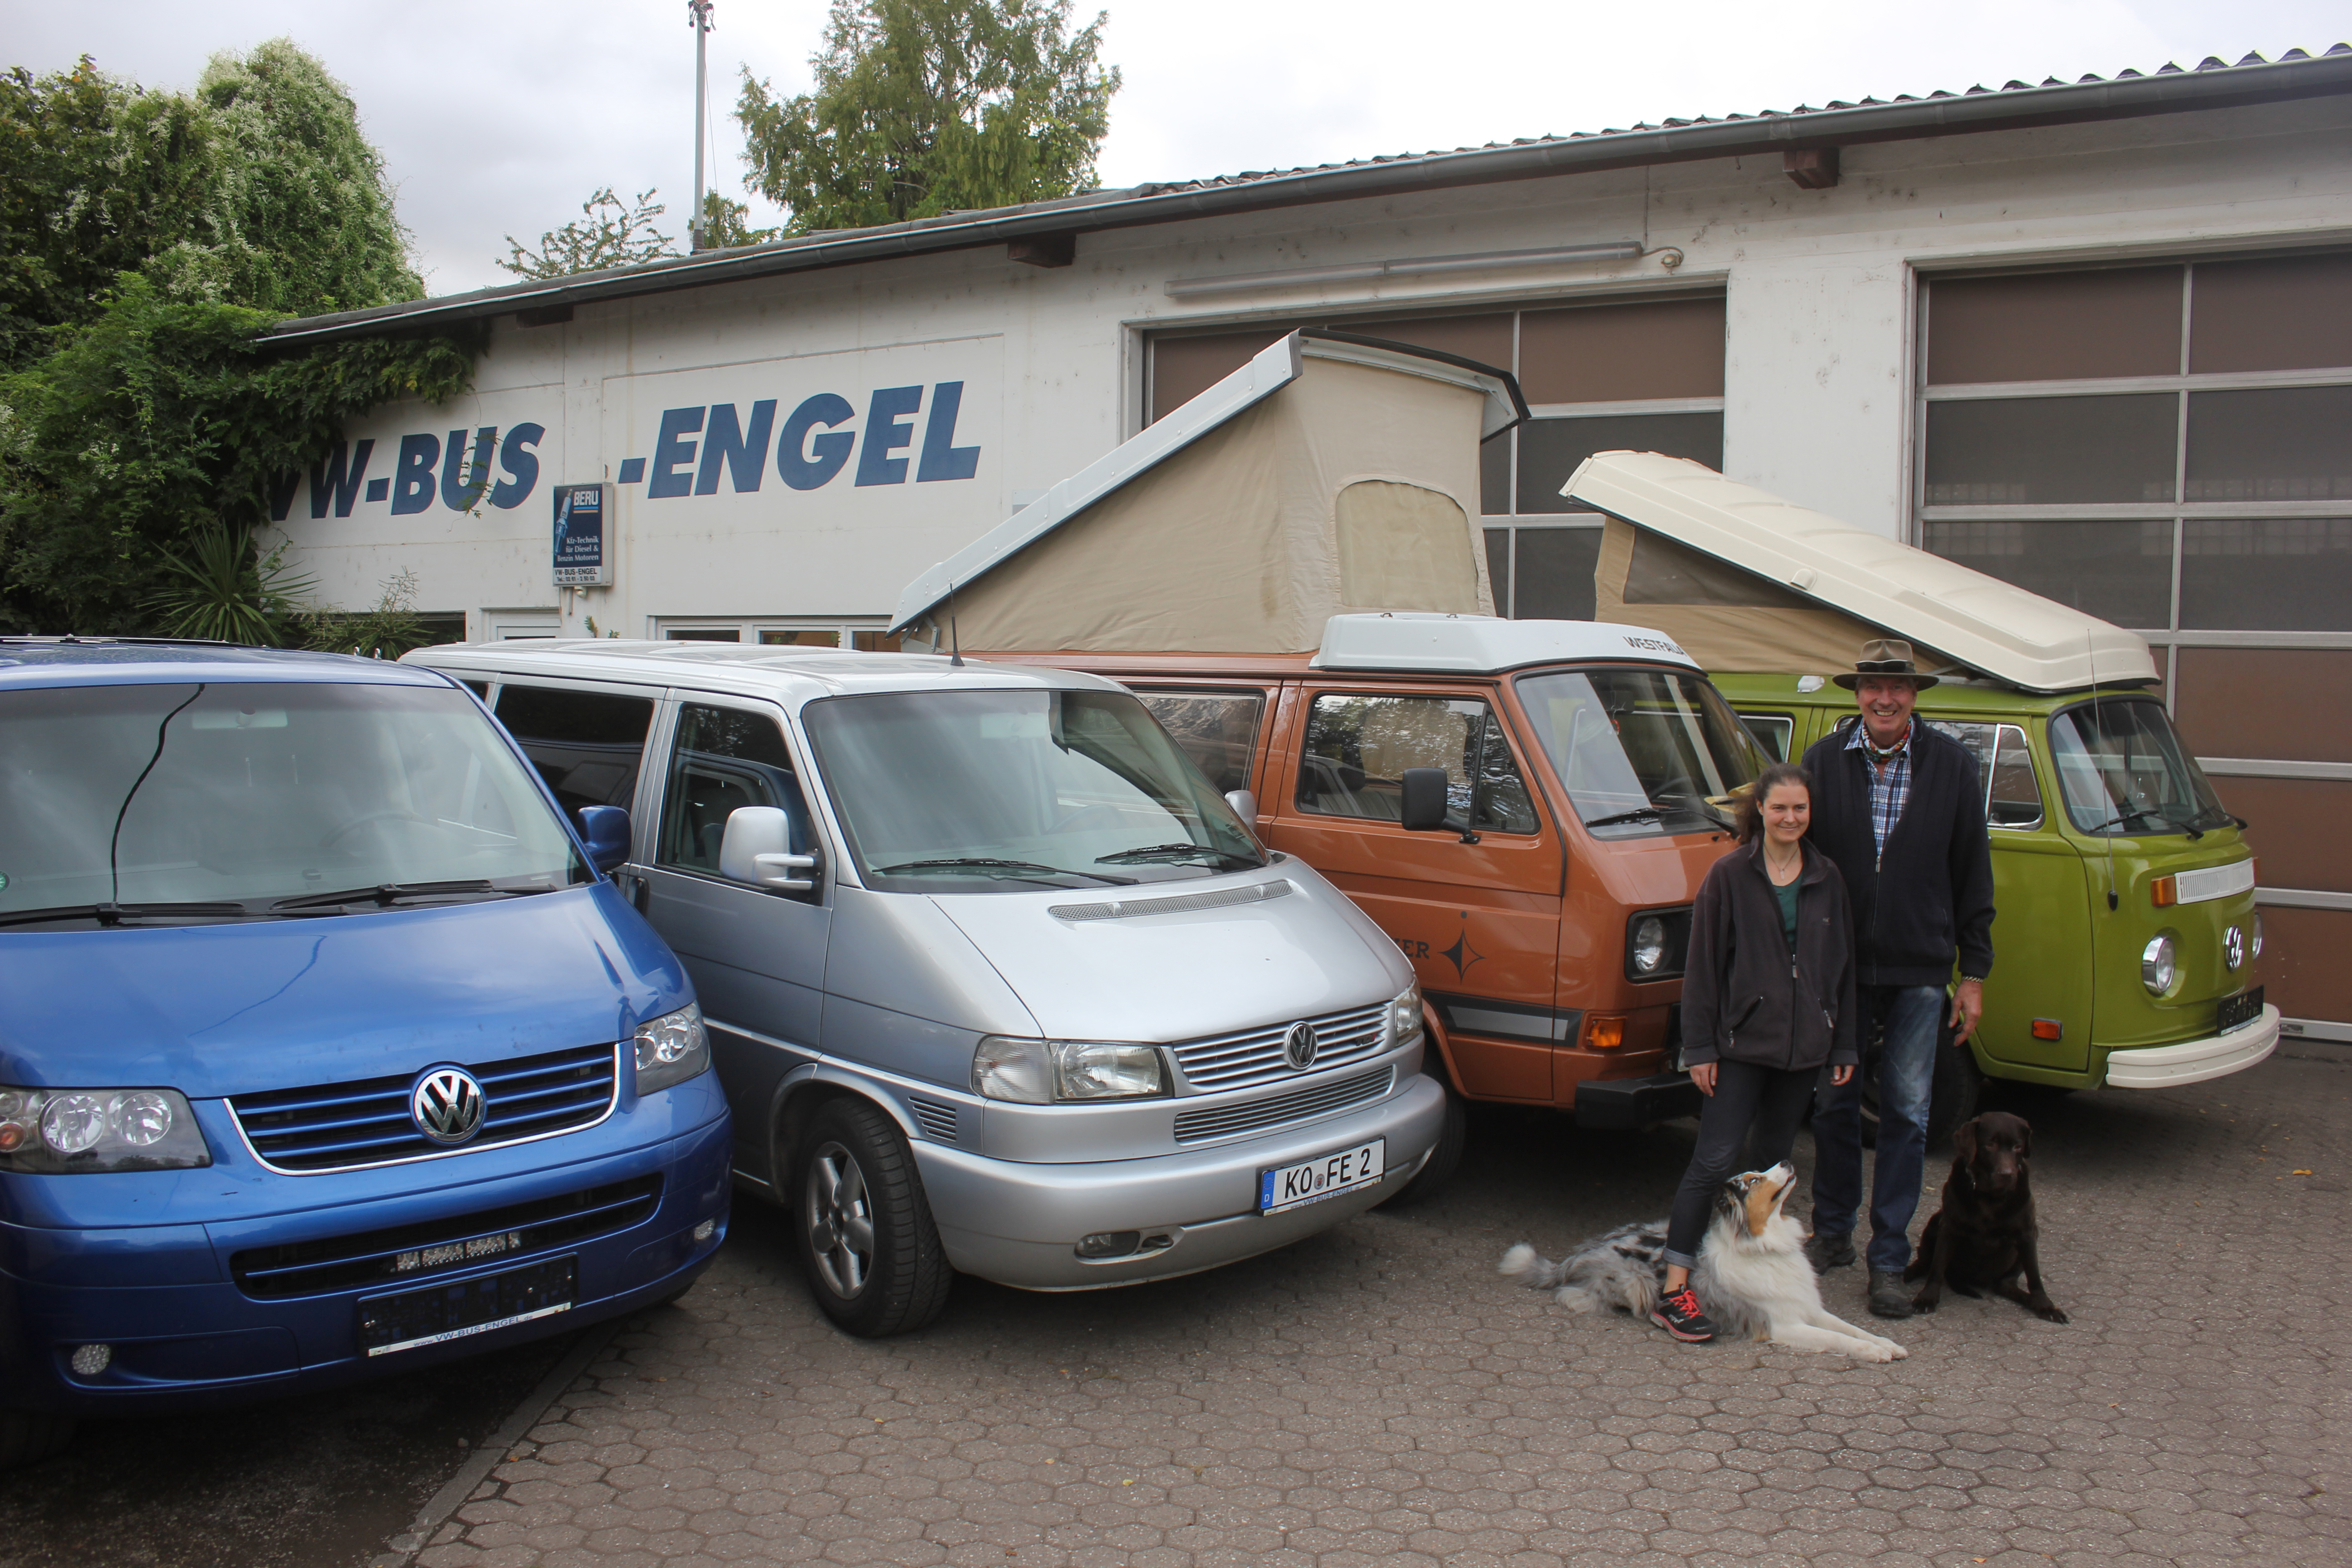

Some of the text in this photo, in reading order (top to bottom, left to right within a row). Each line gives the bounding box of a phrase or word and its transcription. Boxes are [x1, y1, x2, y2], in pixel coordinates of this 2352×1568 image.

[573, 490, 599, 506] BERU
[567, 536, 599, 544] Kfz-Technik
[575, 544, 592, 553] Diesel
[414, 1070, 481, 1142] VW
[1285, 1148, 1370, 1199] KO FE 2
[1264, 1194, 1269, 1203] D
